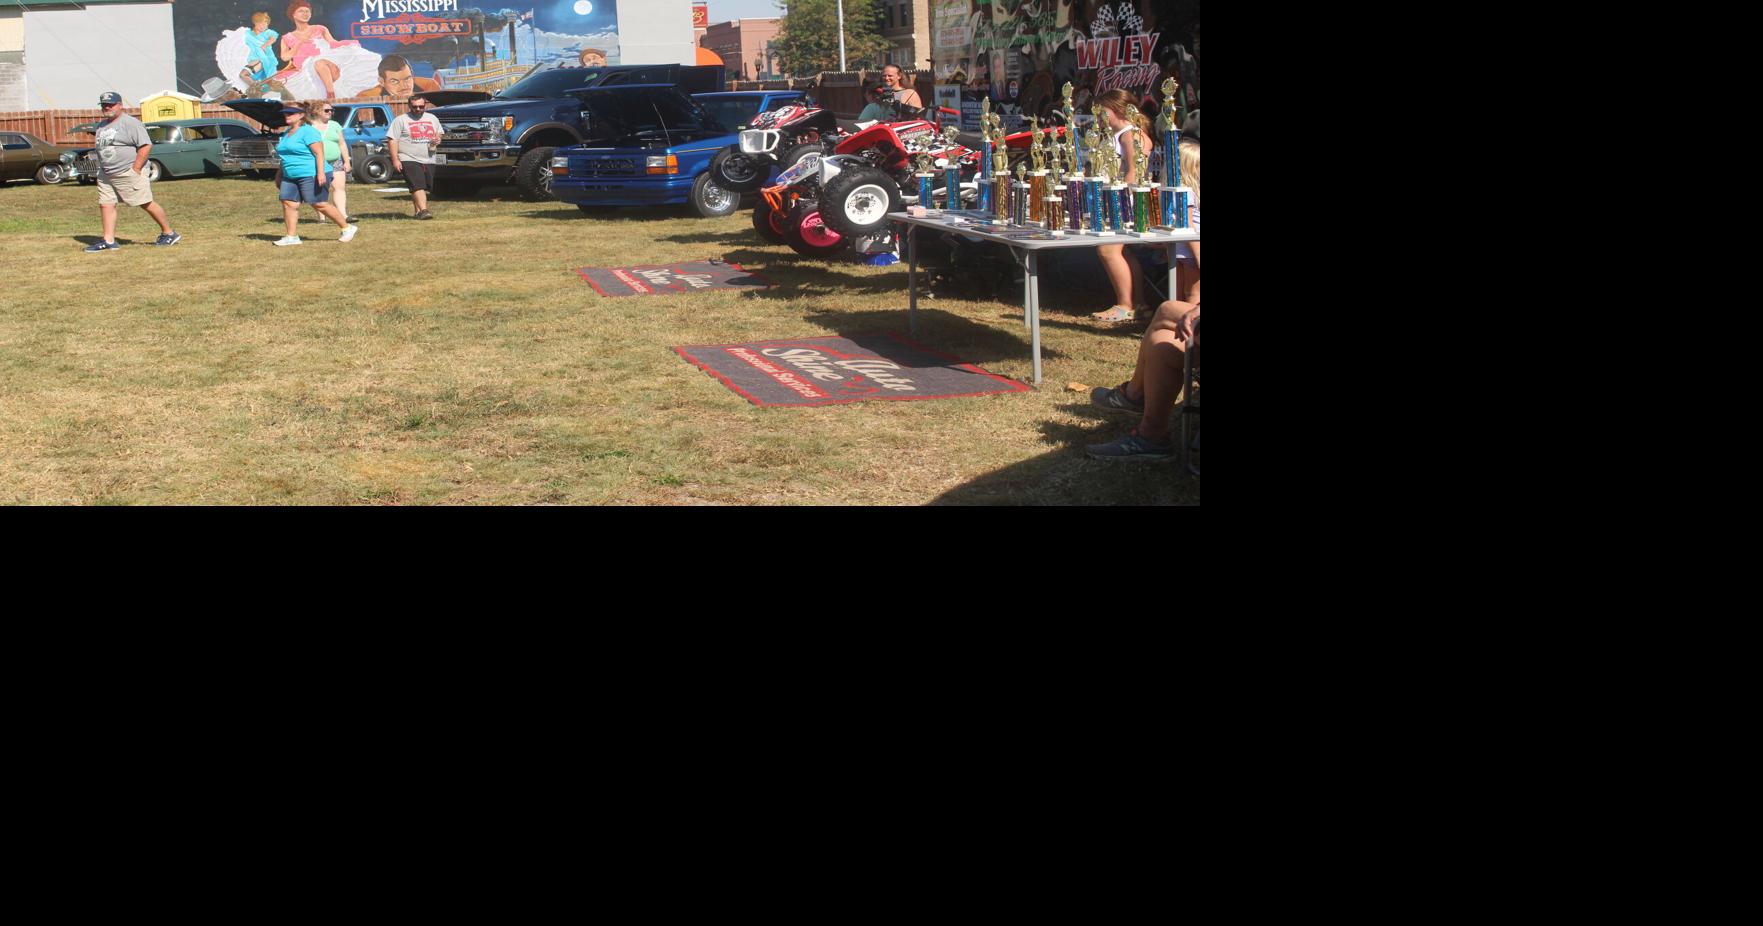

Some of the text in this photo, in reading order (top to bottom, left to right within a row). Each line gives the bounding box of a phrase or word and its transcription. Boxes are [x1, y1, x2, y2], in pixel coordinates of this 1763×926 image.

[359, 0, 458, 22] MISSISSIPPI
[360, 22, 463, 35] SHOWBOAT
[1076, 33, 1160, 70] WILEY
[1095, 62, 1161, 97] Racing
[761, 348, 844, 382] Shine
